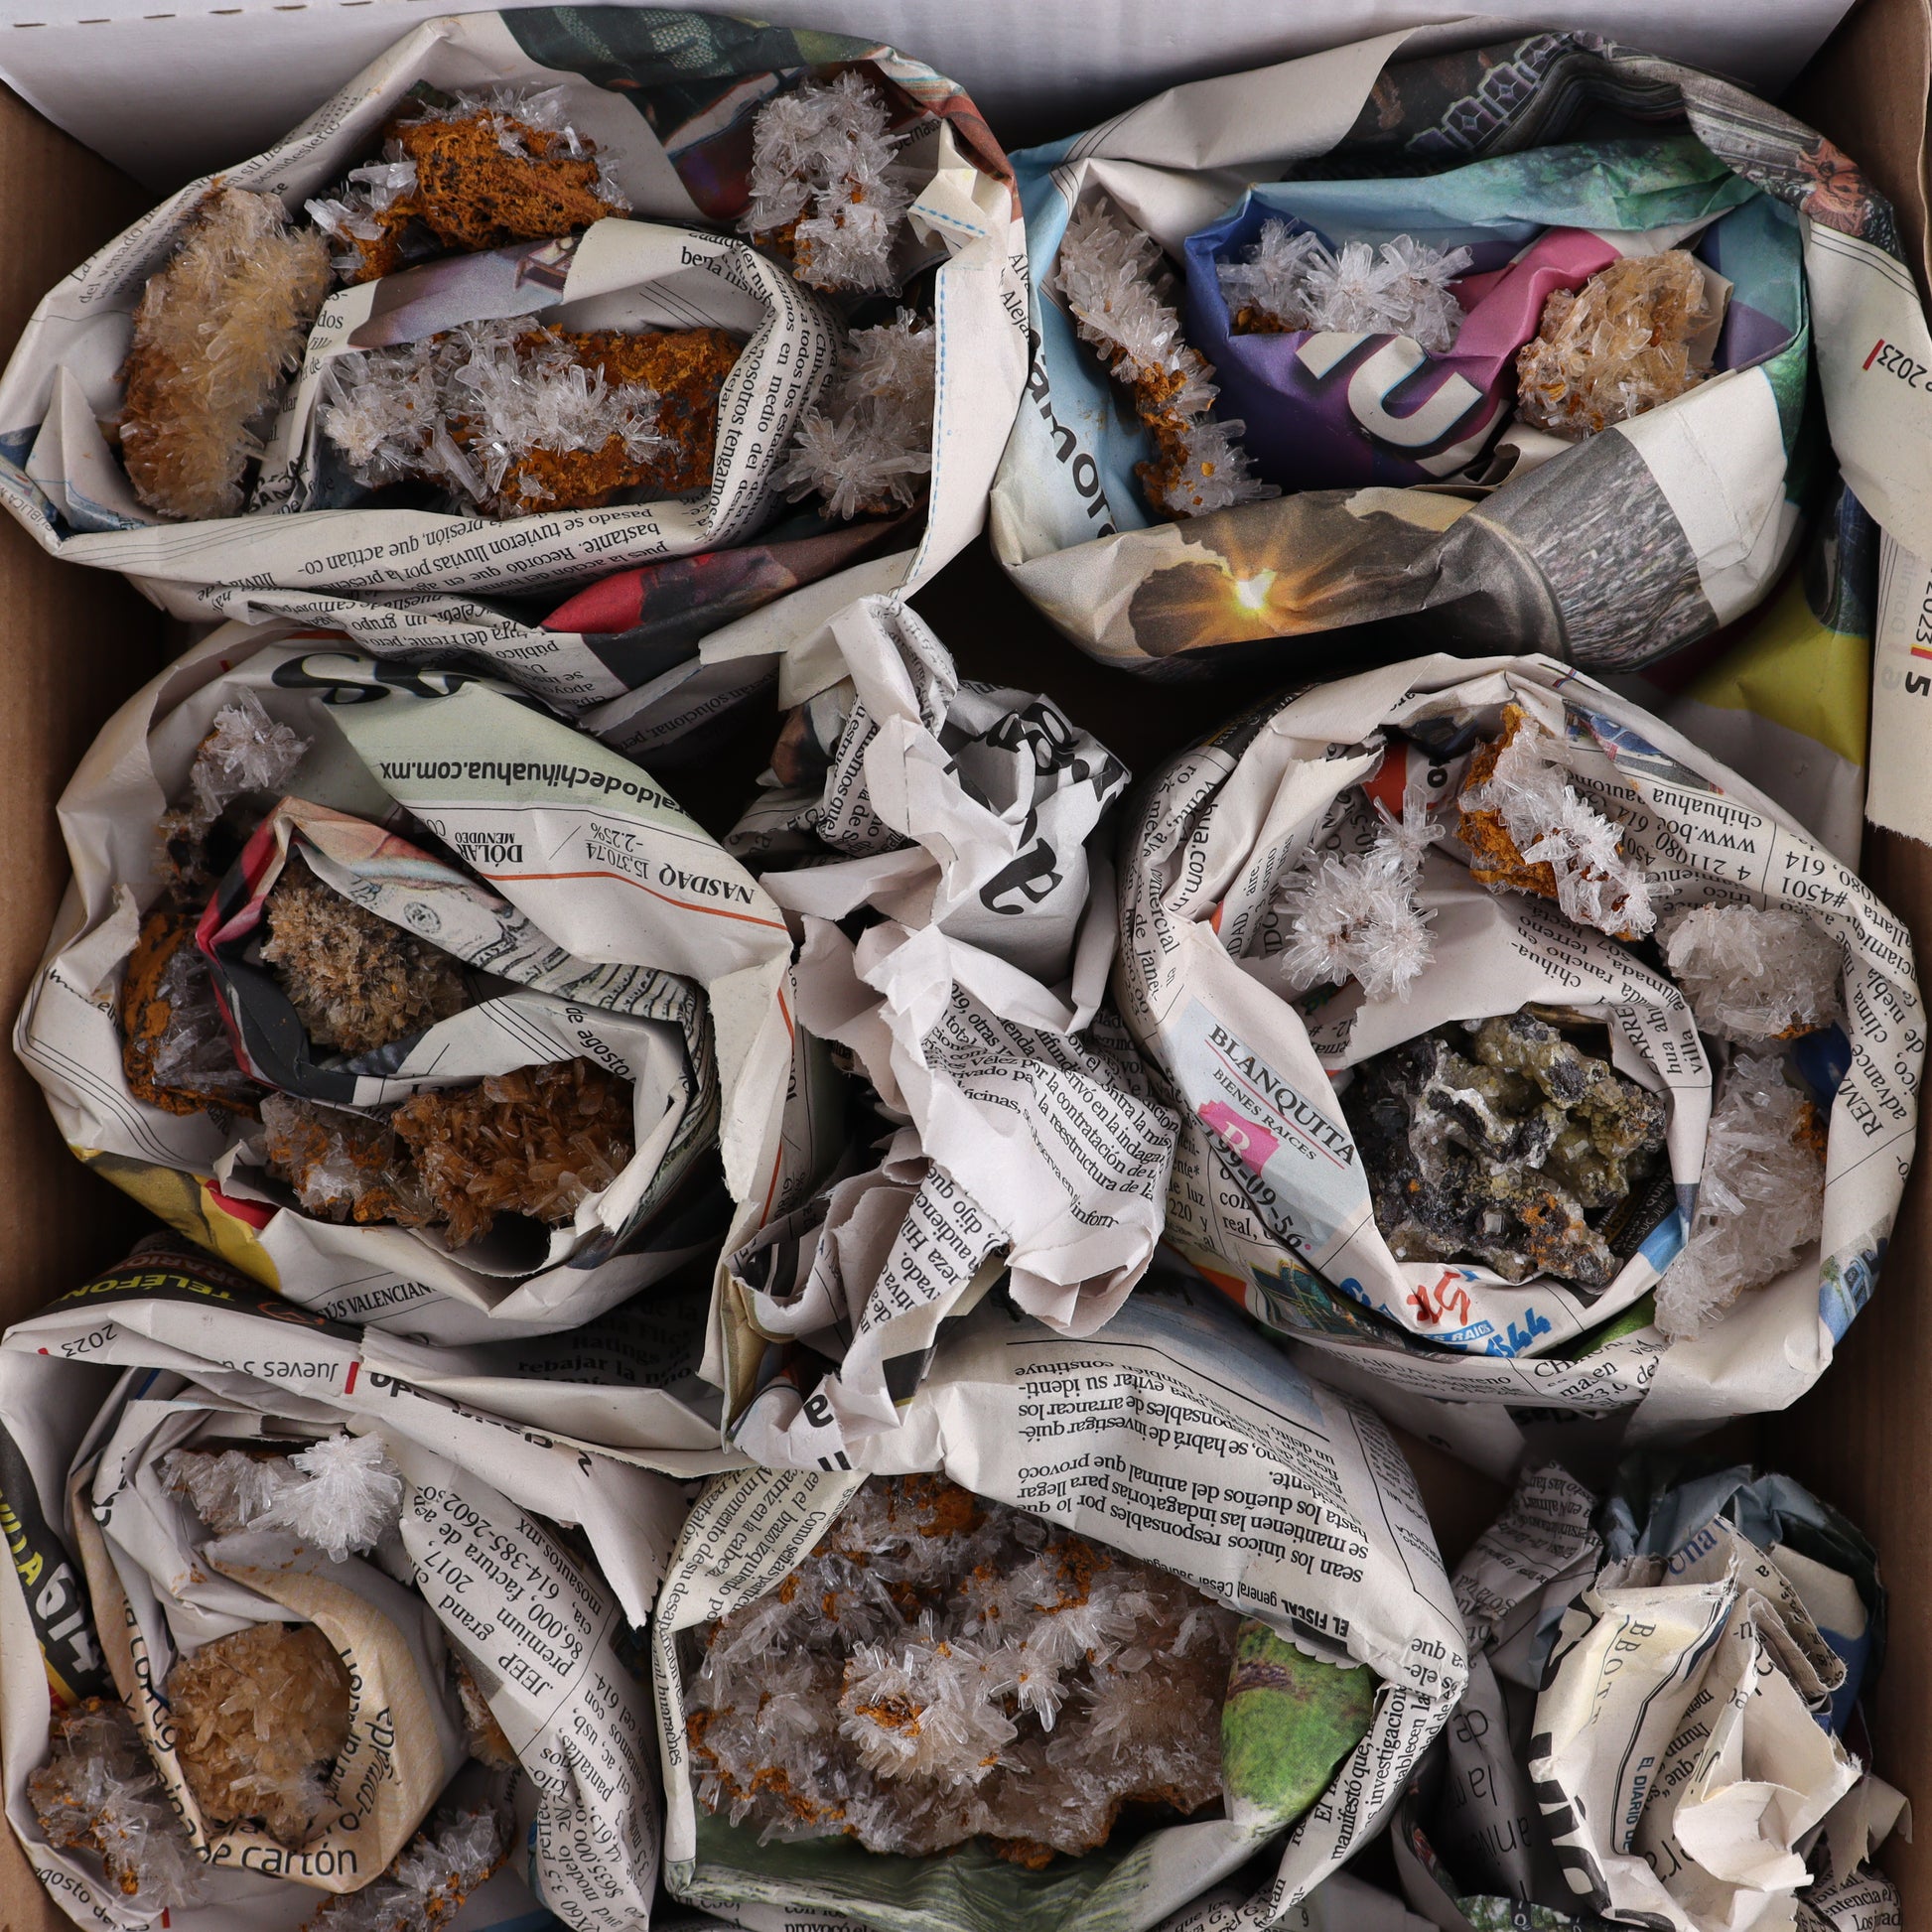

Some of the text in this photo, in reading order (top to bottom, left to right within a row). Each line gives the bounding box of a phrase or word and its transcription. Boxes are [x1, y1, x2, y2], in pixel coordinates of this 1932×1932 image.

[1873, 344, 1927, 388] 2023
[745, 342, 791, 470] en medio del
[745, 329, 811, 501] todos los estados de
[703, 346, 764, 515] nosotros tengamos
[297, 514, 483, 575] presión, que actúan co-
[387, 516, 584, 581] se tuvieron lluvias por la
[442, 522, 660, 587] bastante. Recordó que en
[559, 559, 605, 580] acción
[350, 613, 397, 637] grupo
[460, 629, 487, 649] del
[1904, 671, 1931, 697] 5
[1652, 788, 1762, 830] chihuahua
[453, 833, 522, 867] DÓLAR
[454, 831, 515, 845] MENUDEO
[586, 839, 648, 879] 15,370.74
[590, 822, 643, 853] -2.25%
[658, 863, 754, 904] NASDAQ
[1261, 847, 1278, 891] como
[1785, 851, 1825, 877] 614
[1782, 877, 1848, 908] #4501
[1129, 913, 1146, 939] de
[1519, 914, 1587, 954] terreno
[1511, 942, 1582, 988] chihua-
[1517, 925, 1613, 984] rancho en
[1866, 967, 1906, 1024] niebla
[565, 1000, 630, 1079] de agosto
[968, 1013, 1000, 1047] otras
[1681, 1029, 1704, 1074] villa
[1848, 983, 1906, 1119] advance clima,
[1903, 1029, 1927, 1053] de
[1085, 1056, 1101, 1073] el
[1661, 1040, 1680, 1074] hua
[1091, 1100, 1120, 1134] en la
[1210, 1027, 1362, 1168] BLANQUITA
[1212, 1068, 1316, 1160] BIENES RAICES
[1036, 1095, 1139, 1193] la reestructura de
[1044, 1073, 1148, 1177] la contratación de
[1132, 1113, 1147, 1131] la
[920, 1164, 983, 1235] dijo que
[1170, 1197, 1208, 1232] 220 y
[1222, 1216, 1257, 1241] real,
[61, 1322, 117, 1356] 2023
[262, 1359, 340, 1384] Jueves
[1015, 1360, 1114, 1376] constituye
[1019, 1372, 1166, 1400] evitar su identi-
[1018, 1395, 1145, 1422] de arrancar los
[1018, 1409, 1226, 1458] habrá de investigar quié-
[1228, 1440, 1249, 1455] se
[1018, 1452, 1220, 1502] del animal que provocó
[1017, 1473, 1247, 1531] las indagatorias para llegar
[1055, 1494, 1221, 1546] responsables por lo
[1223, 1488, 1293, 1516] dueños
[1296, 1500, 1321, 1524] los
[679, 1475, 759, 1581] momento de su
[704, 1502, 768, 1578] en la cabeza.
[719, 1470, 819, 1595] en el brazo izquierdo
[766, 1510, 827, 1578] Como señas
[1251, 1516, 1369, 1559] se mantienen
[444, 1493, 592, 1635] cia, 614-385-2602
[516, 1518, 606, 1614] mosautos.mx
[1227, 1535, 1363, 1583] sean los únicos
[425, 1540, 574, 1676] premium 2017,
[438, 1522, 584, 1659] 86,000, factura de
[1236, 1581, 1350, 1637] EL FISCAL general
[438, 1593, 494, 1641] grand
[1411, 1637, 1447, 1660] que
[1403, 1663, 1439, 1684] ele-
[595, 1672, 640, 1731] cel 614-
[584, 1689, 645, 1793] contamos con
[653, 1684, 682, 1766] huaraches
[556, 1727, 618, 1801] pantallas,
[572, 1707, 636, 1795] cil, ac, usb,
[527, 1765, 571, 1796] kilo-
[1331, 1740, 1373, 1875] manifestó que,
[240, 1841, 357, 1876] cartón
[559, 1845, 623, 1928] awd modelo
